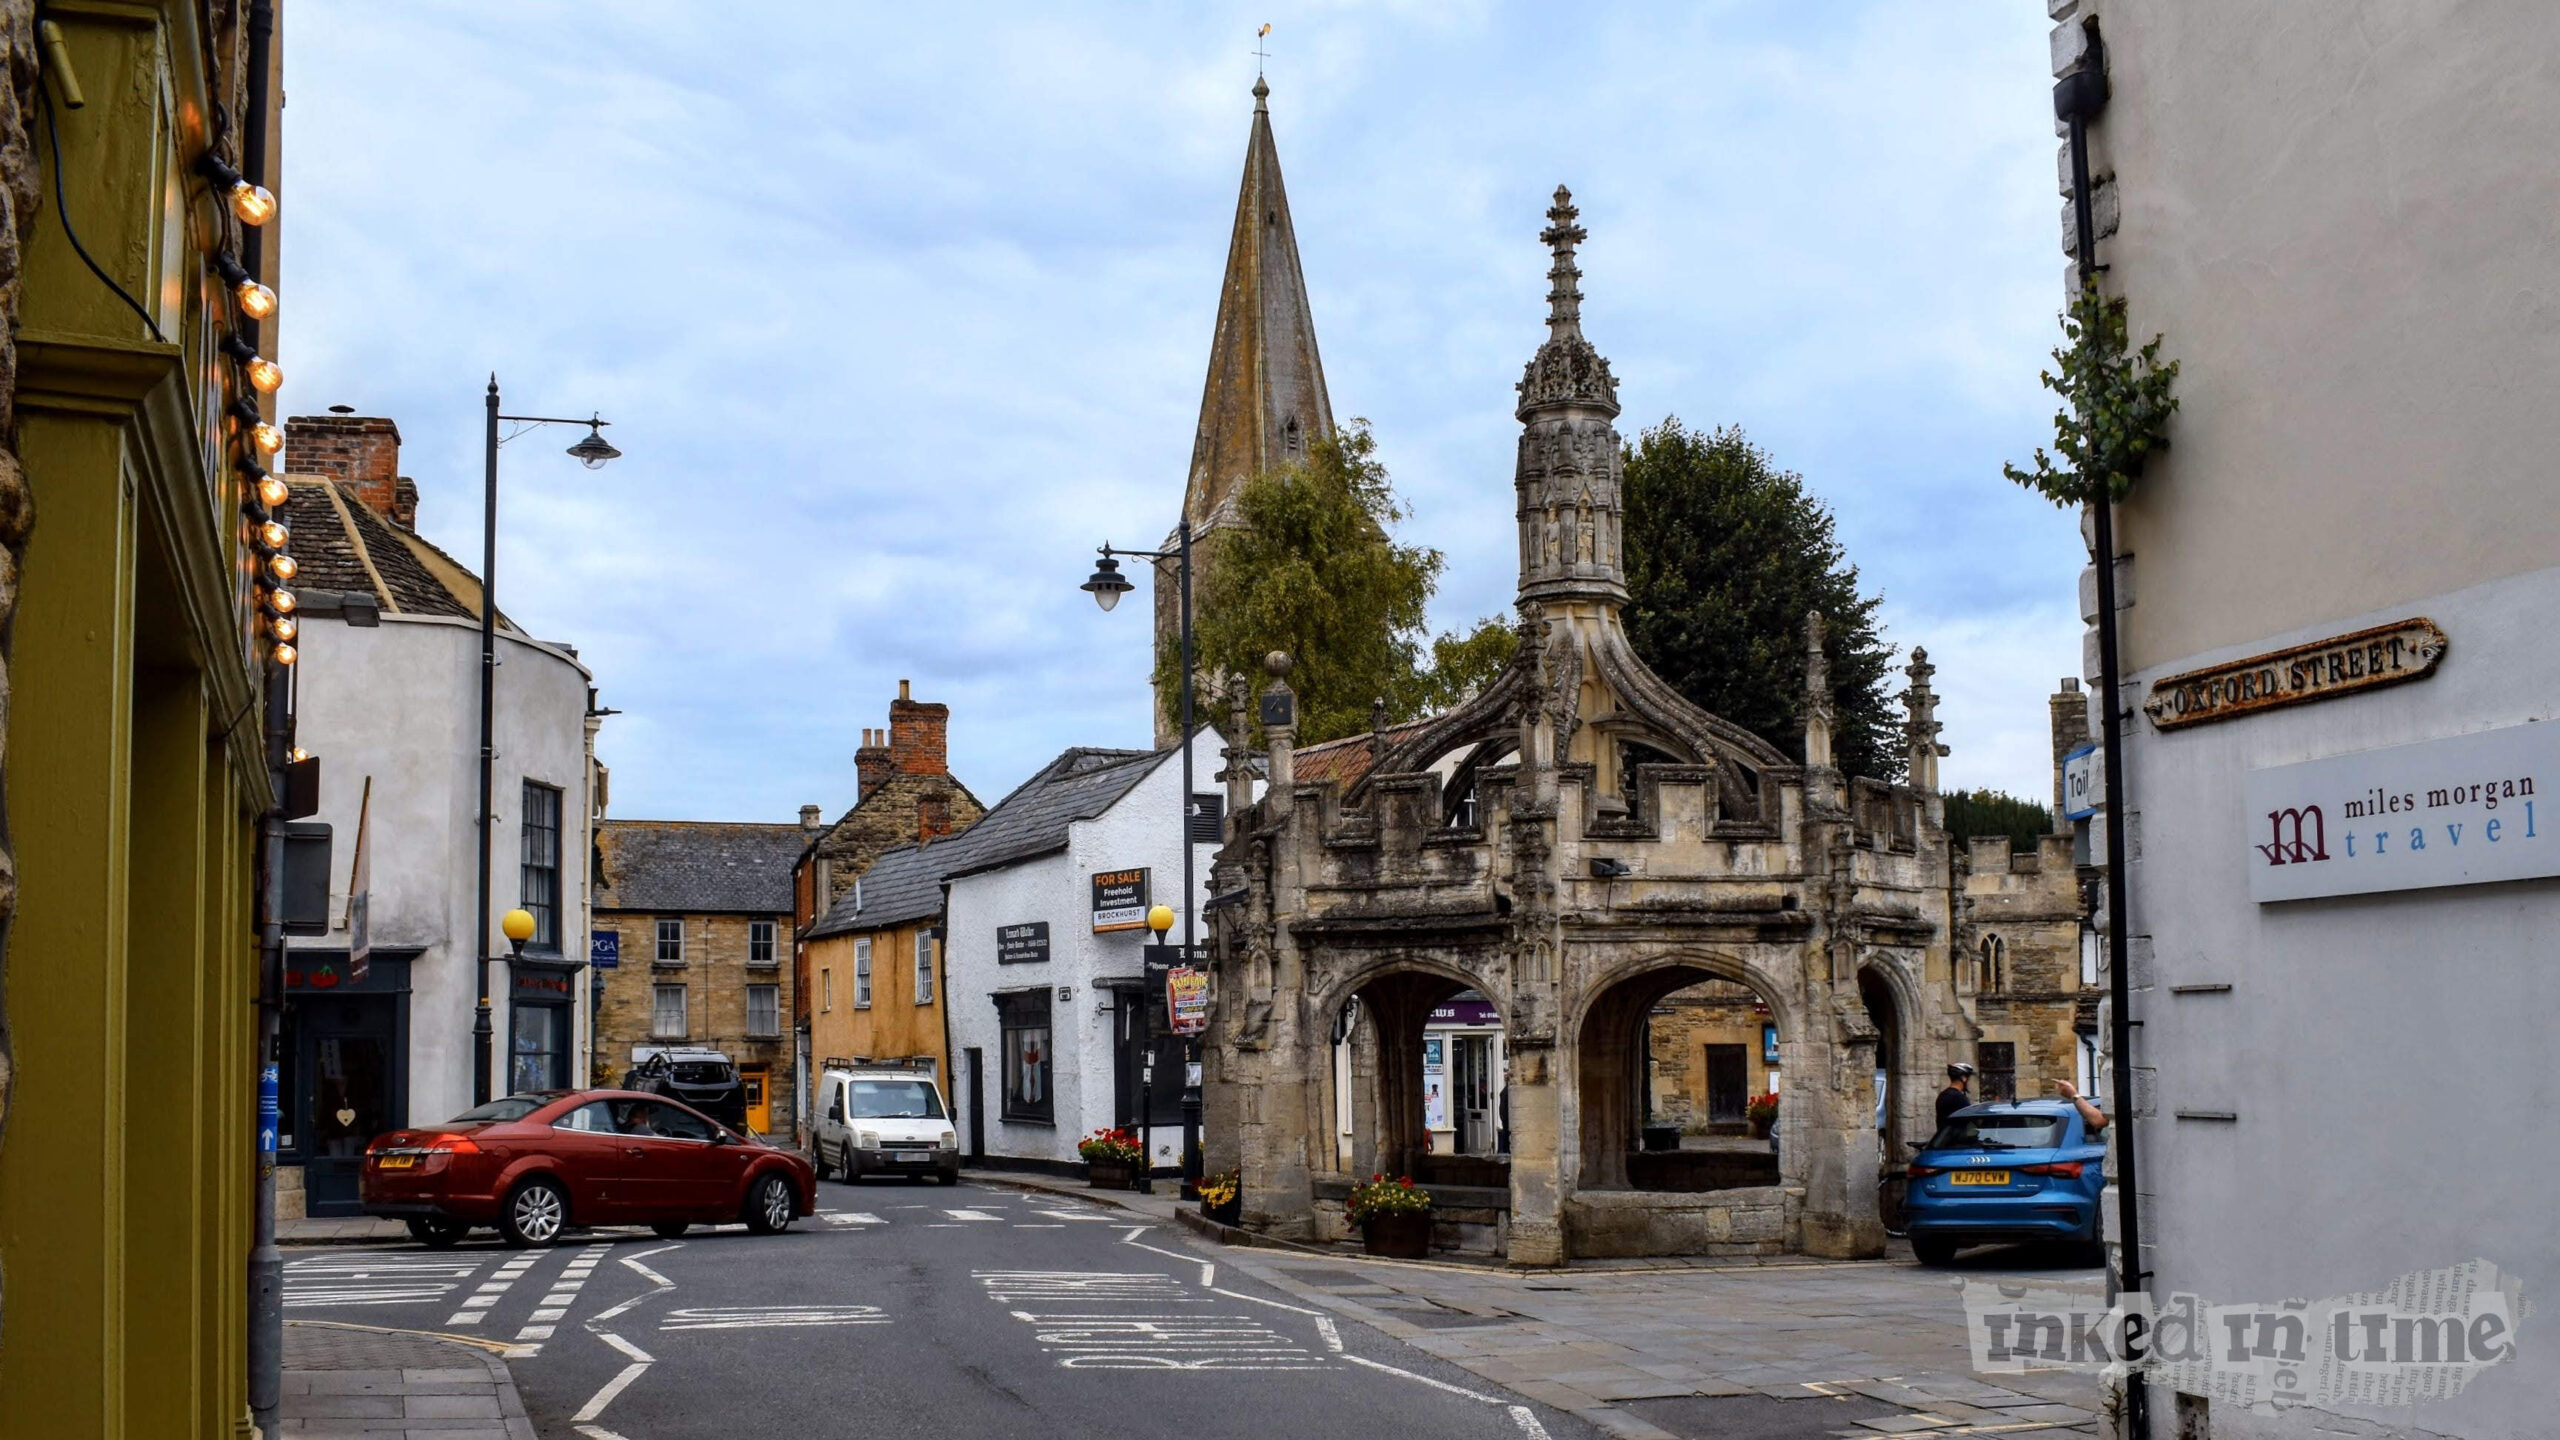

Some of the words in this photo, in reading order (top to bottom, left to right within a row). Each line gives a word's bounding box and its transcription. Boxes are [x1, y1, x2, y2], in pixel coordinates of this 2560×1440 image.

[2173, 668, 2278, 715] OXFORD
[2290, 636, 2407, 690] STREET
[2344, 787, 2415, 819] miles
[2427, 775, 2536, 810] morgan
[2345, 800, 2536, 857] travel
[1096, 875, 1115, 886] FOR
[1117, 871, 1141, 882] SALE
[1104, 886, 1133, 897] Freehold
[1100, 896, 1137, 907] Investment
[1098, 909, 1140, 920] BROCKHURST
